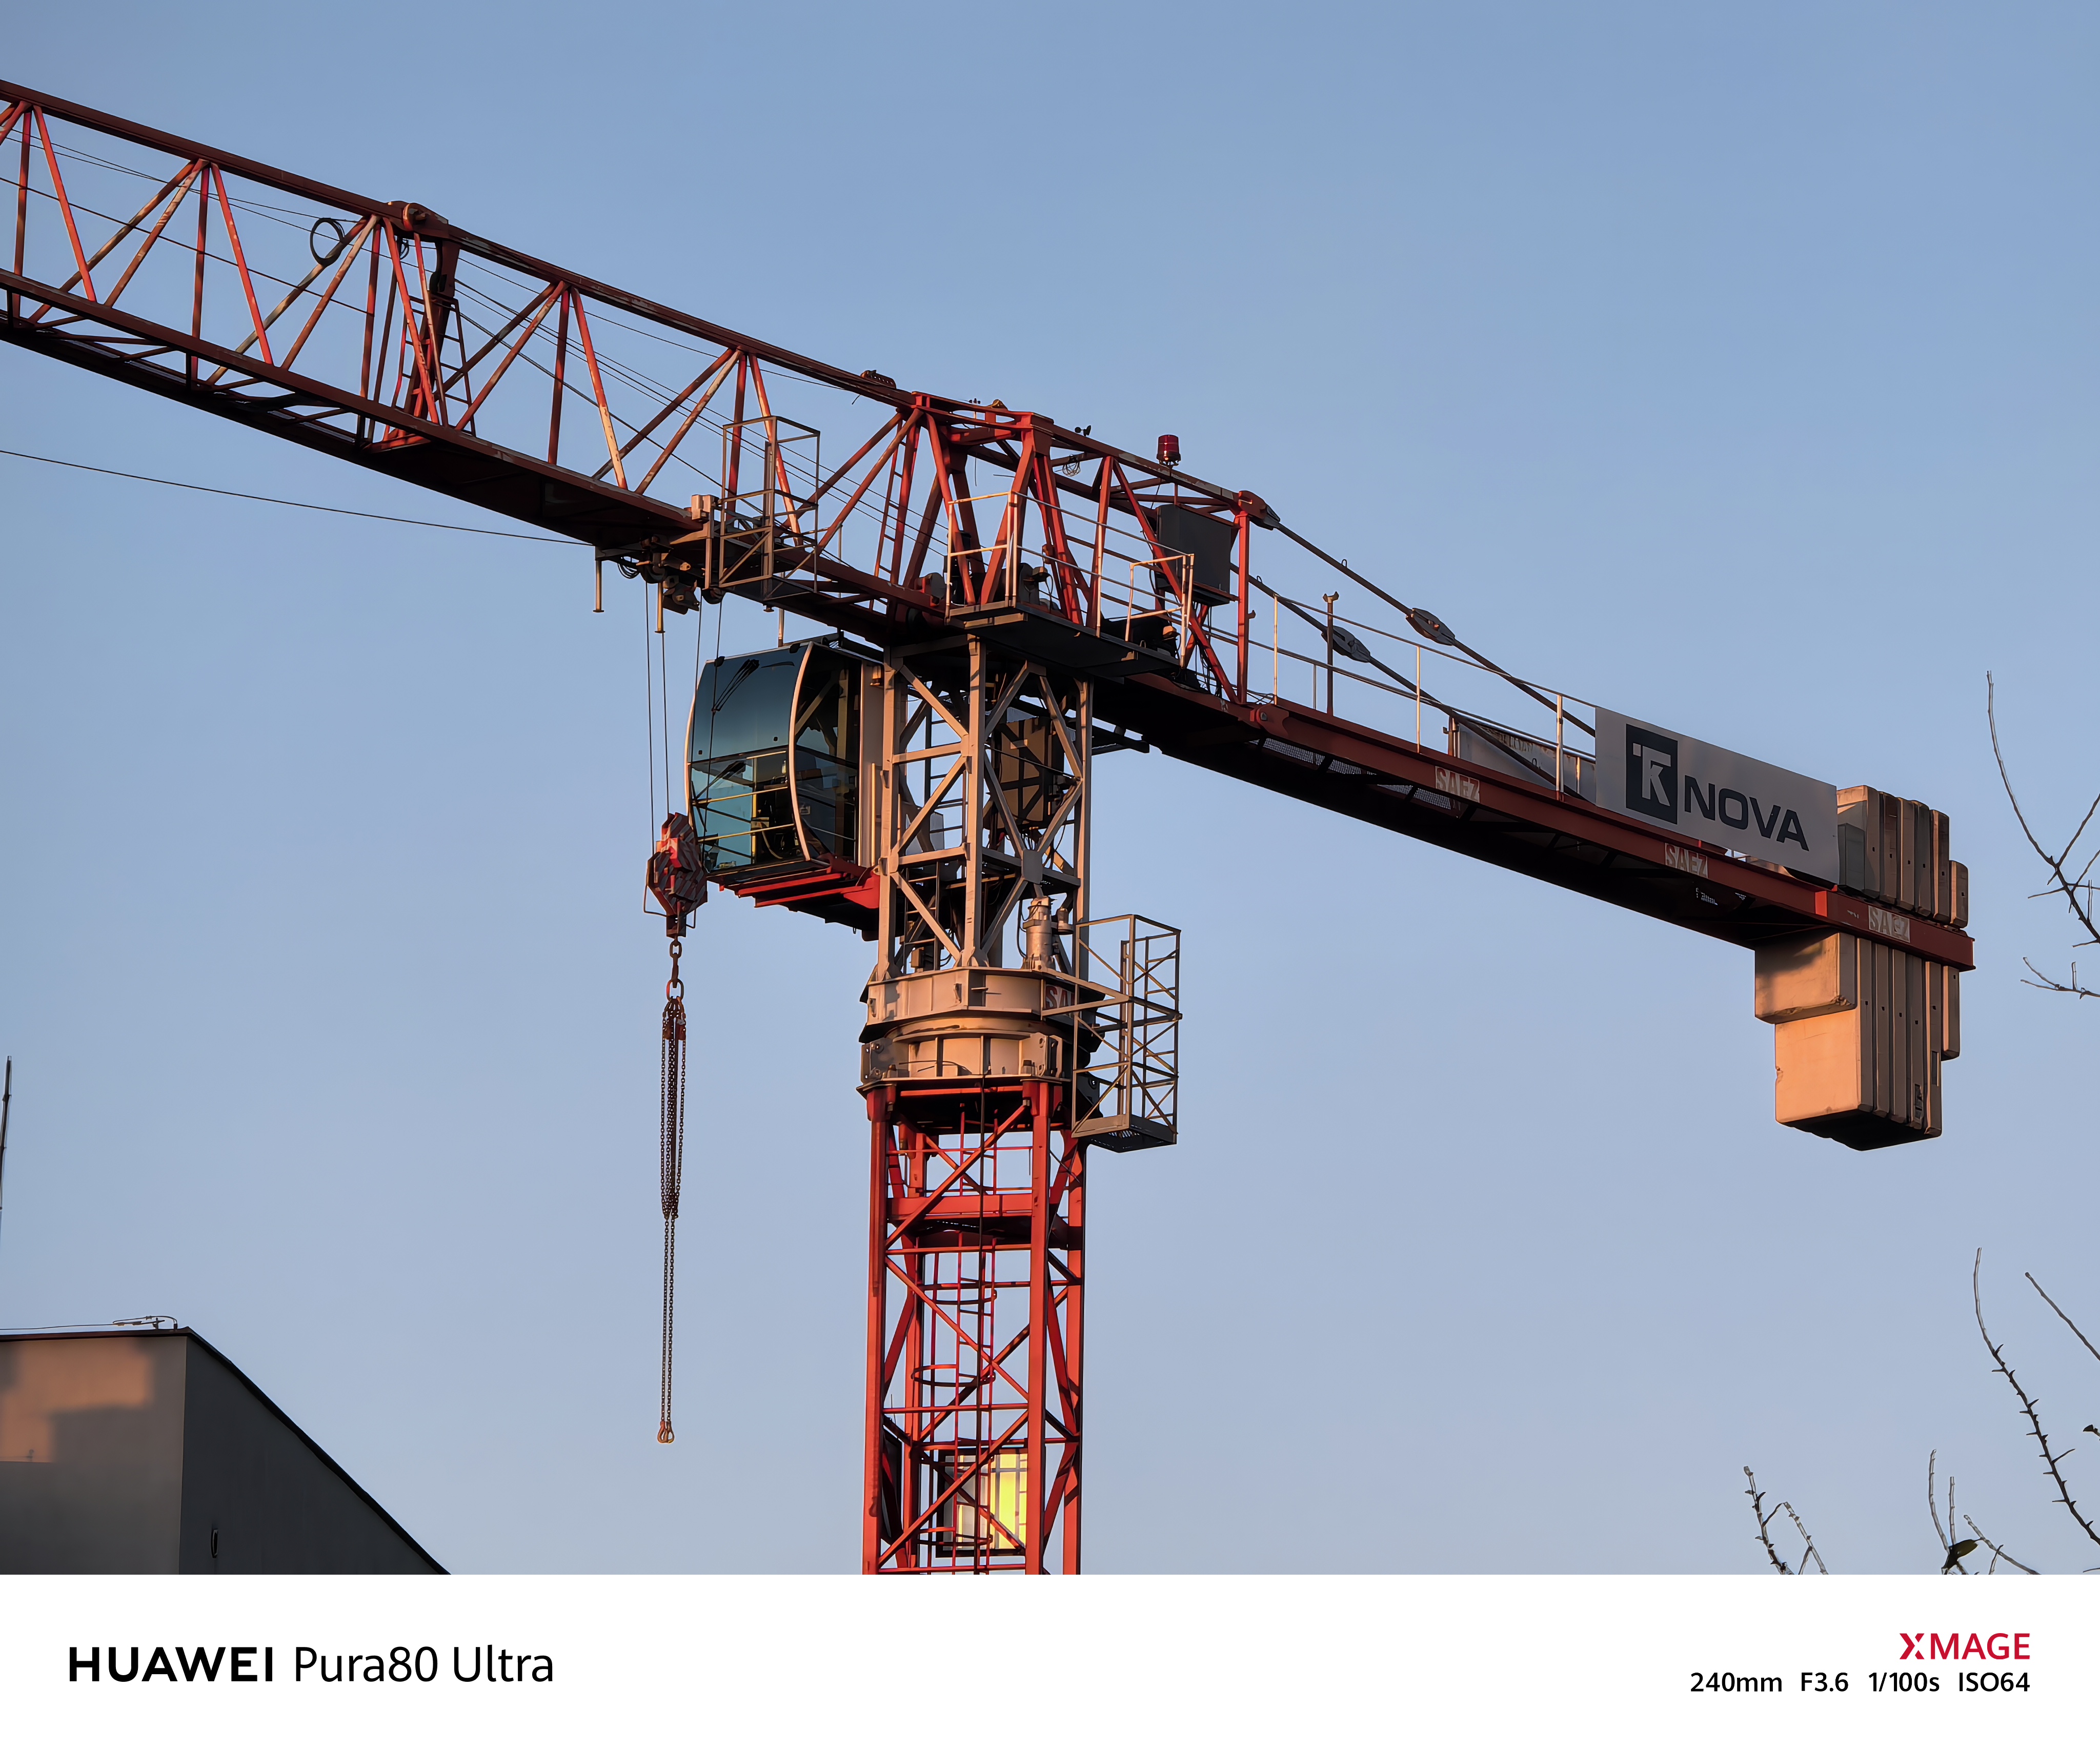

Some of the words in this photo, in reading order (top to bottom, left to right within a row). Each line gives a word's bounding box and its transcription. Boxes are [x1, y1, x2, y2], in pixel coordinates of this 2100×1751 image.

[1436, 767, 1479, 802] SAEZ
[1685, 775, 1810, 851] NOVA
[1666, 844, 1707, 877] SAEZ
